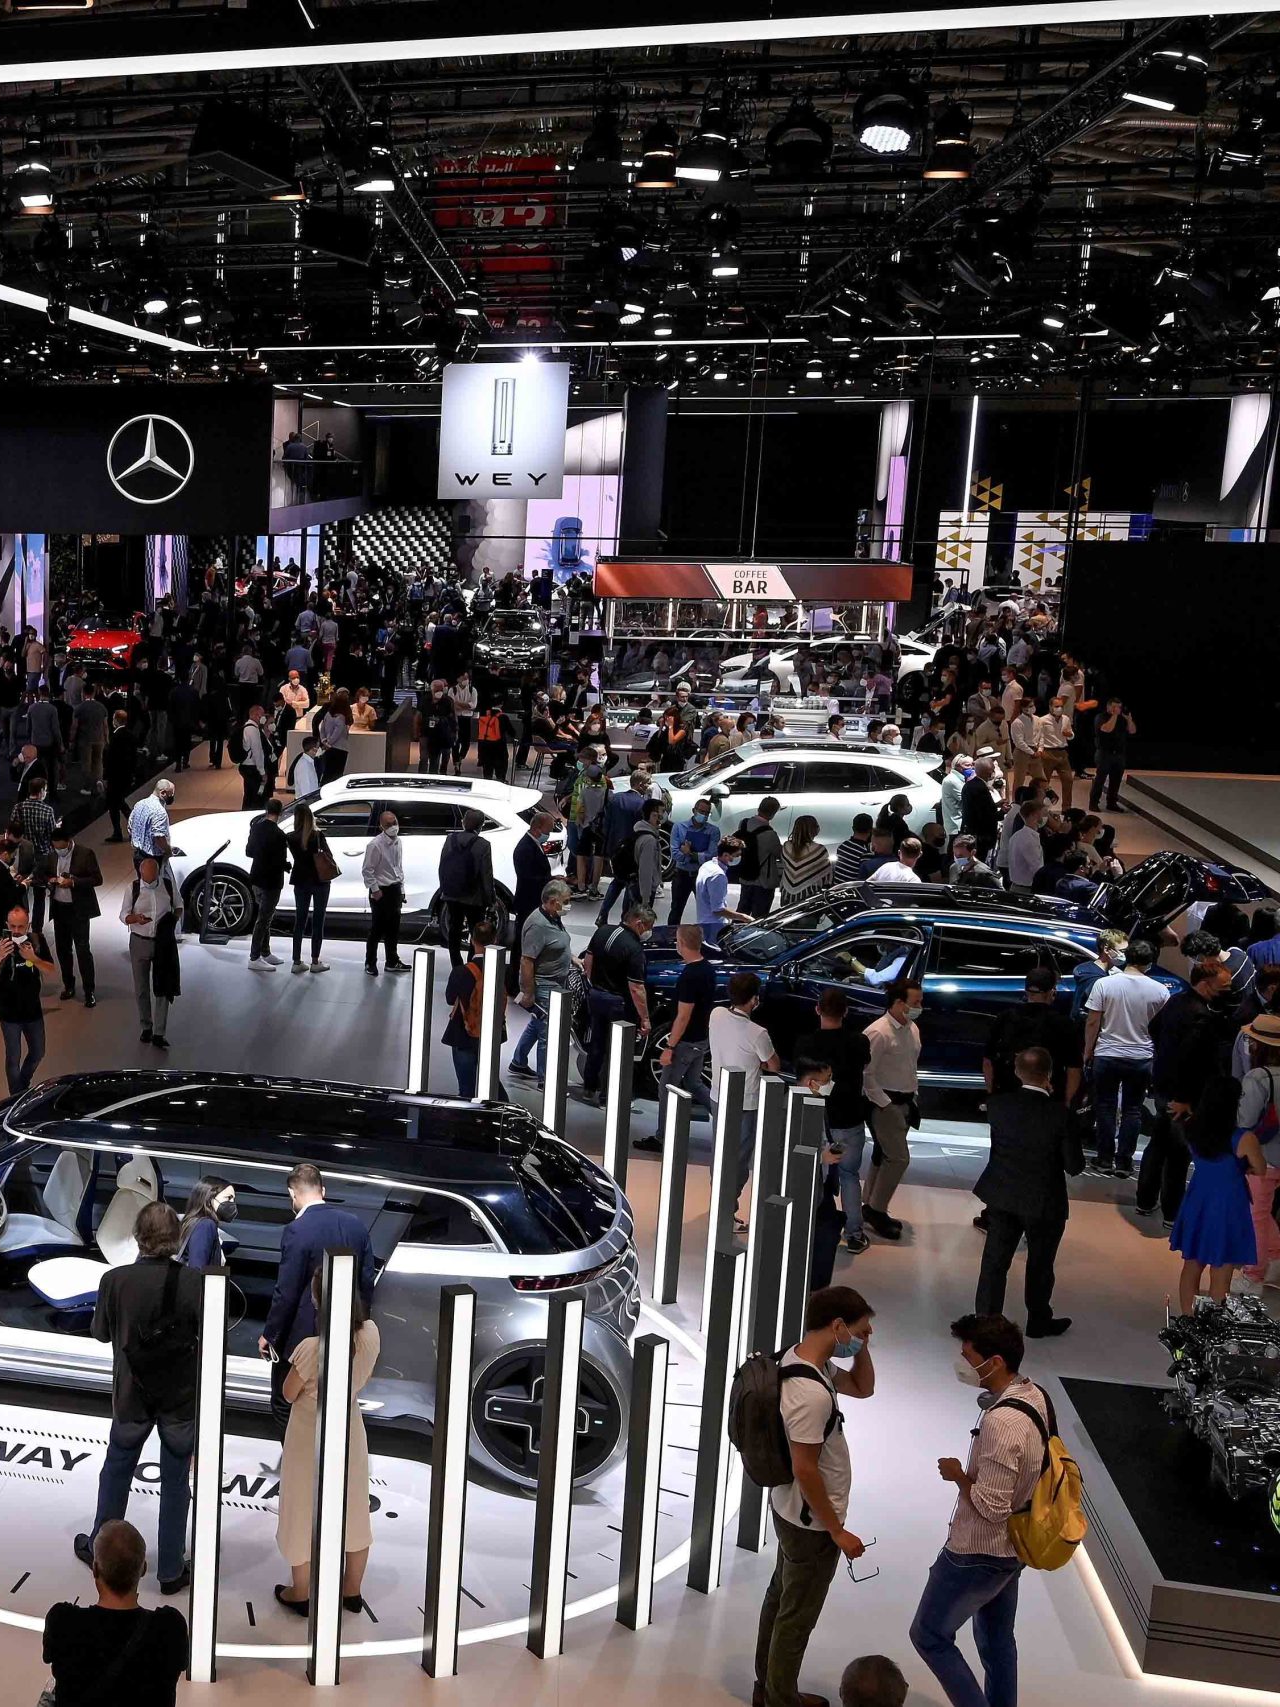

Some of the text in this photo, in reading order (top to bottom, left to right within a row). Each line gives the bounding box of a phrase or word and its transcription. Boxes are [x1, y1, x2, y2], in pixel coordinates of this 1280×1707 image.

[455, 473, 547, 486] WEY
[734, 570, 768, 579] COFFEE
[732, 580, 768, 594] BAR
